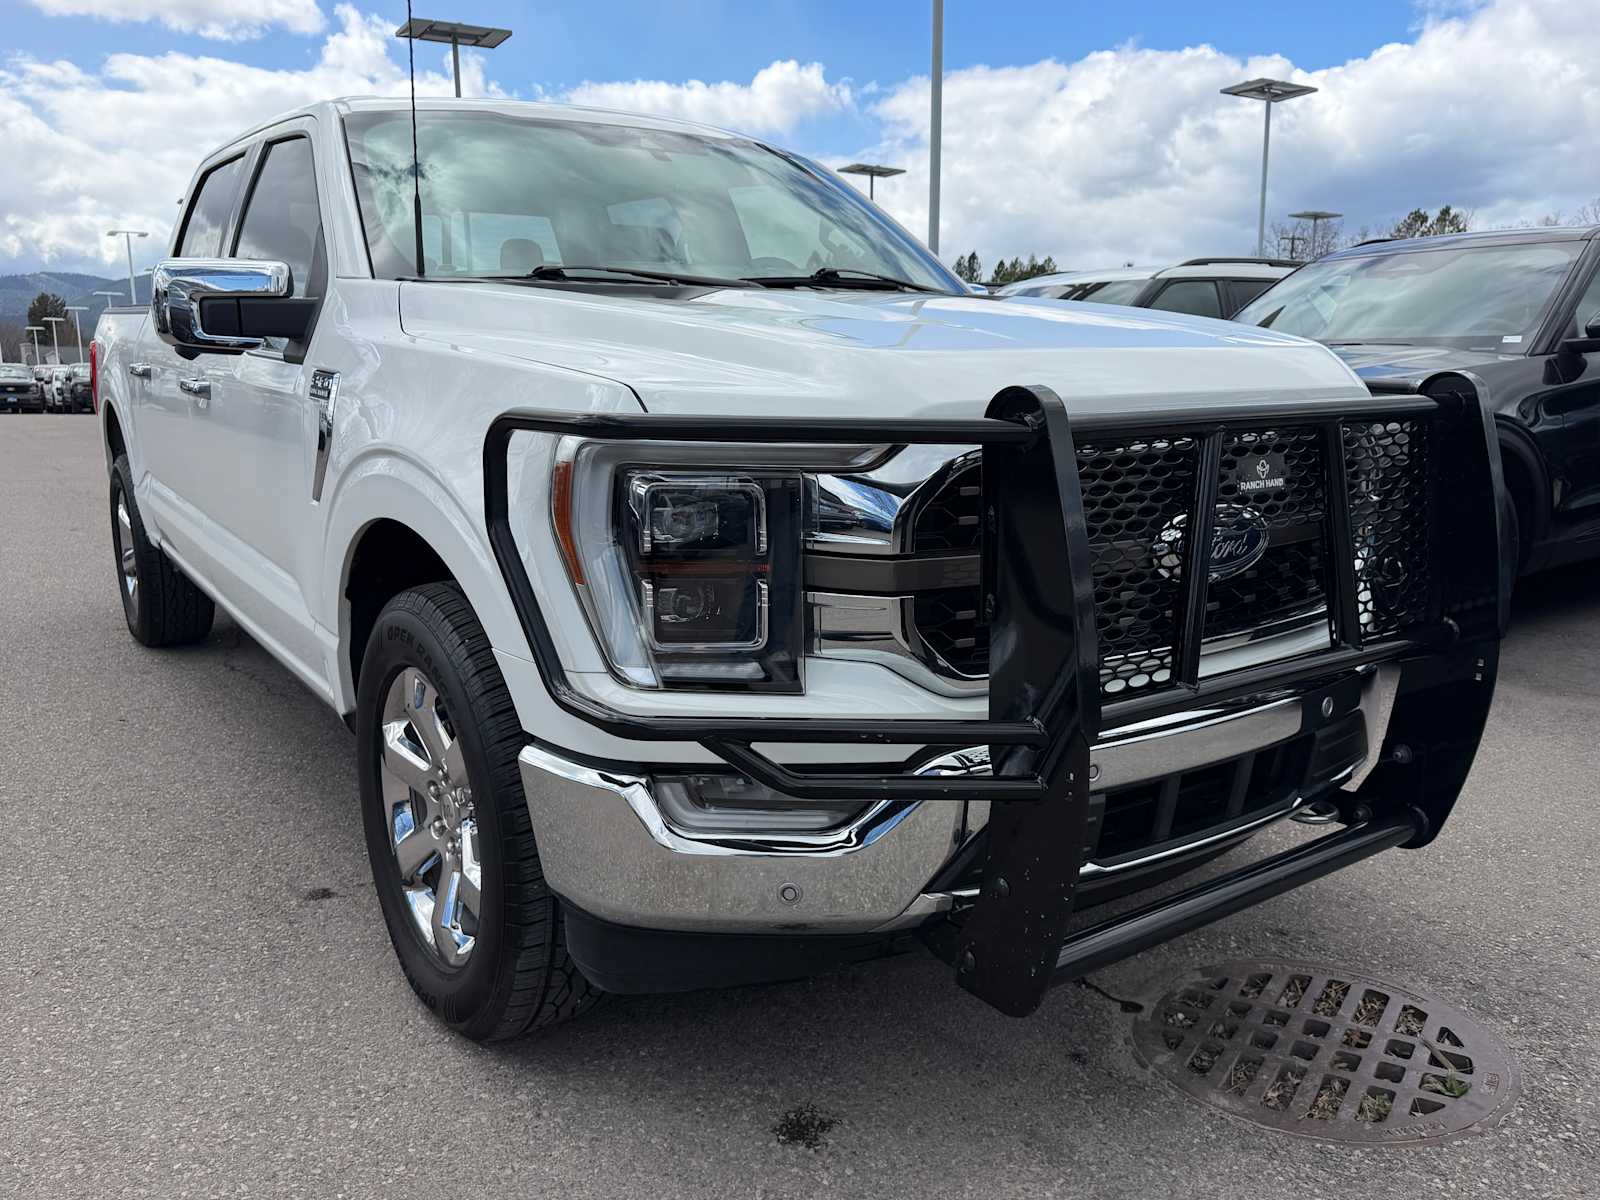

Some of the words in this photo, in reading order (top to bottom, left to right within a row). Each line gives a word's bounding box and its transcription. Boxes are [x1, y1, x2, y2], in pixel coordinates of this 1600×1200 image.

[1240, 479, 1265, 491] RANCH
[1265, 477, 1283, 488] HAND
[387, 625, 415, 648] OPEN
